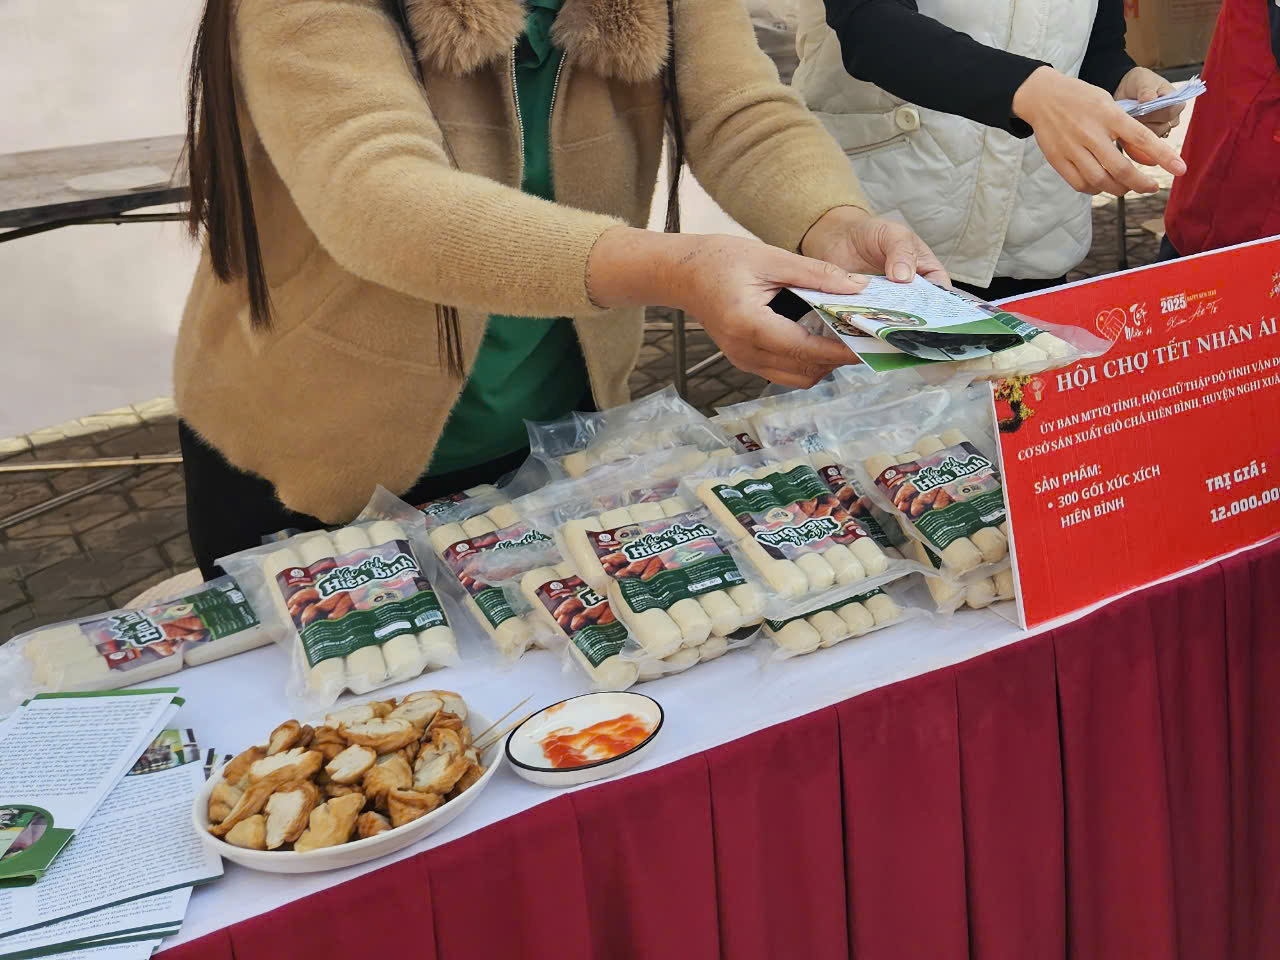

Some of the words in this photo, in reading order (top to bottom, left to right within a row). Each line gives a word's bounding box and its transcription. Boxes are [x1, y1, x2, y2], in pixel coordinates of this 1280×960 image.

[1160, 296, 1186, 314] 2025
[1056, 364, 1098, 392] HỘI
[1103, 350, 1148, 379] CHỢ
[1153, 337, 1191, 365] TẾT
[1197, 324, 1252, 353] NHÂN
[1258, 316, 1278, 338] ÁI
[1057, 414, 1080, 429] BAN
[1081, 404, 1111, 422] MTTQ
[1142, 389, 1161, 404] HỘI
[1162, 382, 1183, 398] CHỮ
[1184, 376, 1210, 391] THẬP
[1212, 371, 1226, 384] ĐỎ
[1227, 365, 1250, 380] TỈNH
[1252, 358, 1271, 373] VẬN
[1017, 447, 1034, 461] CƠ
[1035, 441, 1050, 456] SỞ
[1051, 435, 1073, 452] SẢN
[1075, 424, 1102, 443] XUẤT
[1104, 419, 1123, 435] GIÒ
[1124, 413, 1146, 429] CHẢ
[1174, 397, 1201, 414] BÌNH,
[1202, 387, 1235, 406] HUYỆN
[1237, 380, 1261, 395] NGHI
[1034, 475, 1060, 495] SẢN
[1057, 491, 1079, 508] 300
[1081, 483, 1104, 500] GÓI
[1107, 474, 1131, 492] XÚC
[1133, 464, 1161, 483] XÍCH
[1205, 472, 1231, 492] TRỊ
[1233, 460, 1259, 482] GIÁ
[1060, 508, 1091, 529] HIÊN
[1093, 496, 1125, 518] BÌNH
[630, 539, 673, 559] Hiên
[675, 525, 713, 543] Bình
[323, 574, 370, 594] Hiên
[373, 557, 414, 579] Bình
